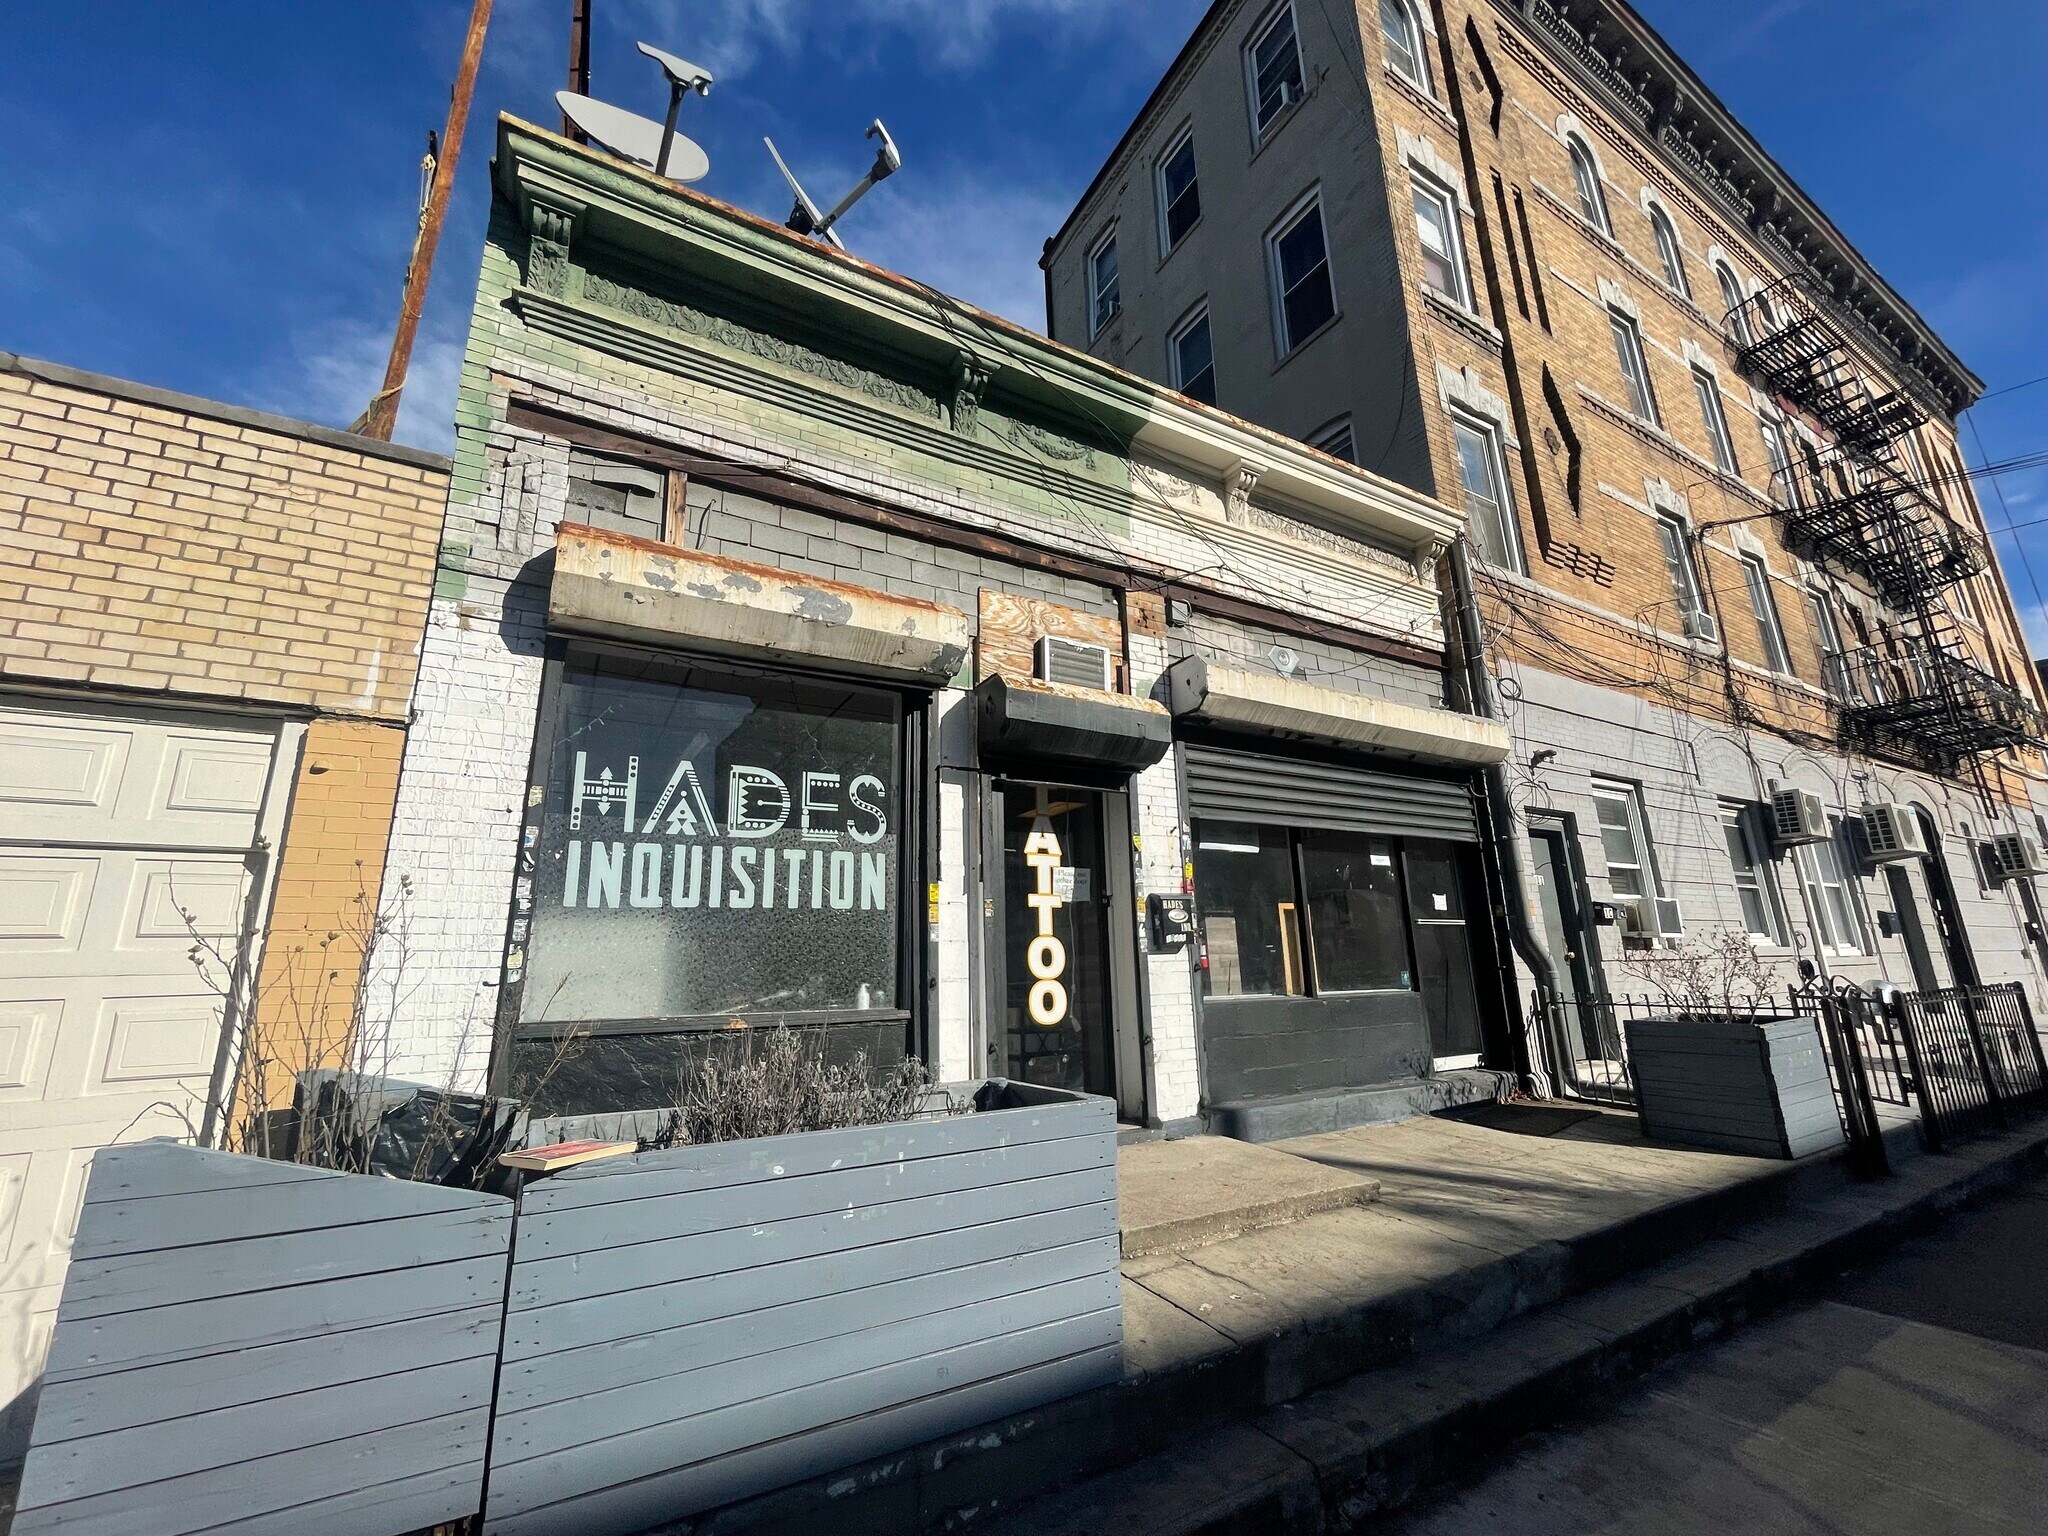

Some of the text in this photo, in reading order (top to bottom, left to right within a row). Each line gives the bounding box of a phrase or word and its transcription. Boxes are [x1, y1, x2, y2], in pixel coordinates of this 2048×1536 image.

[569, 751, 887, 844] HADES
[563, 840, 886, 910] INQUISITION
[1162, 900, 1184, 910] HADES
